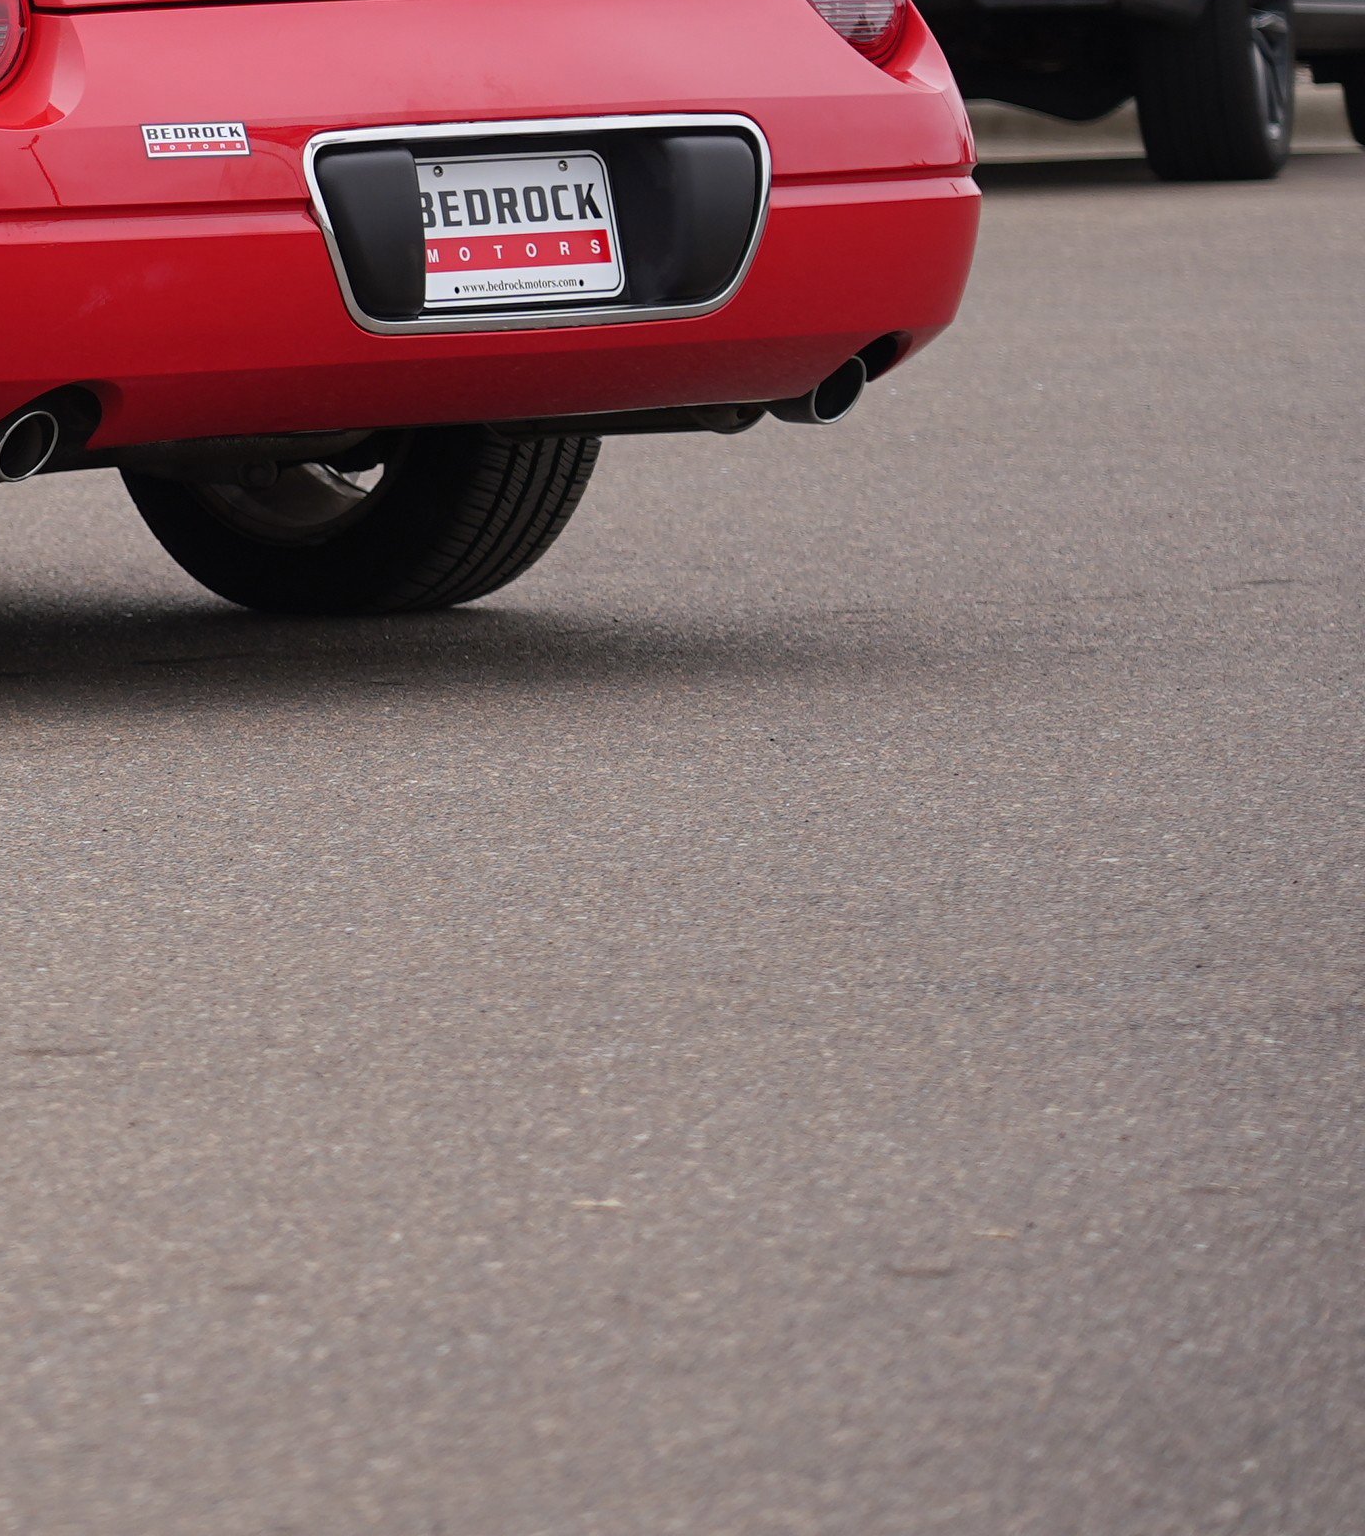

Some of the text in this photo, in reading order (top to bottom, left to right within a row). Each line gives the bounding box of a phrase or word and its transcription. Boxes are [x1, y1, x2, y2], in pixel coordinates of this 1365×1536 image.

[146, 126, 242, 140] BEDROCK
[154, 143, 241, 151] MOTORS
[419, 183, 603, 228] BEDROCK
[427, 240, 601, 263] MOTORS
[462, 277, 577, 294] www.bedrockmotors.com
